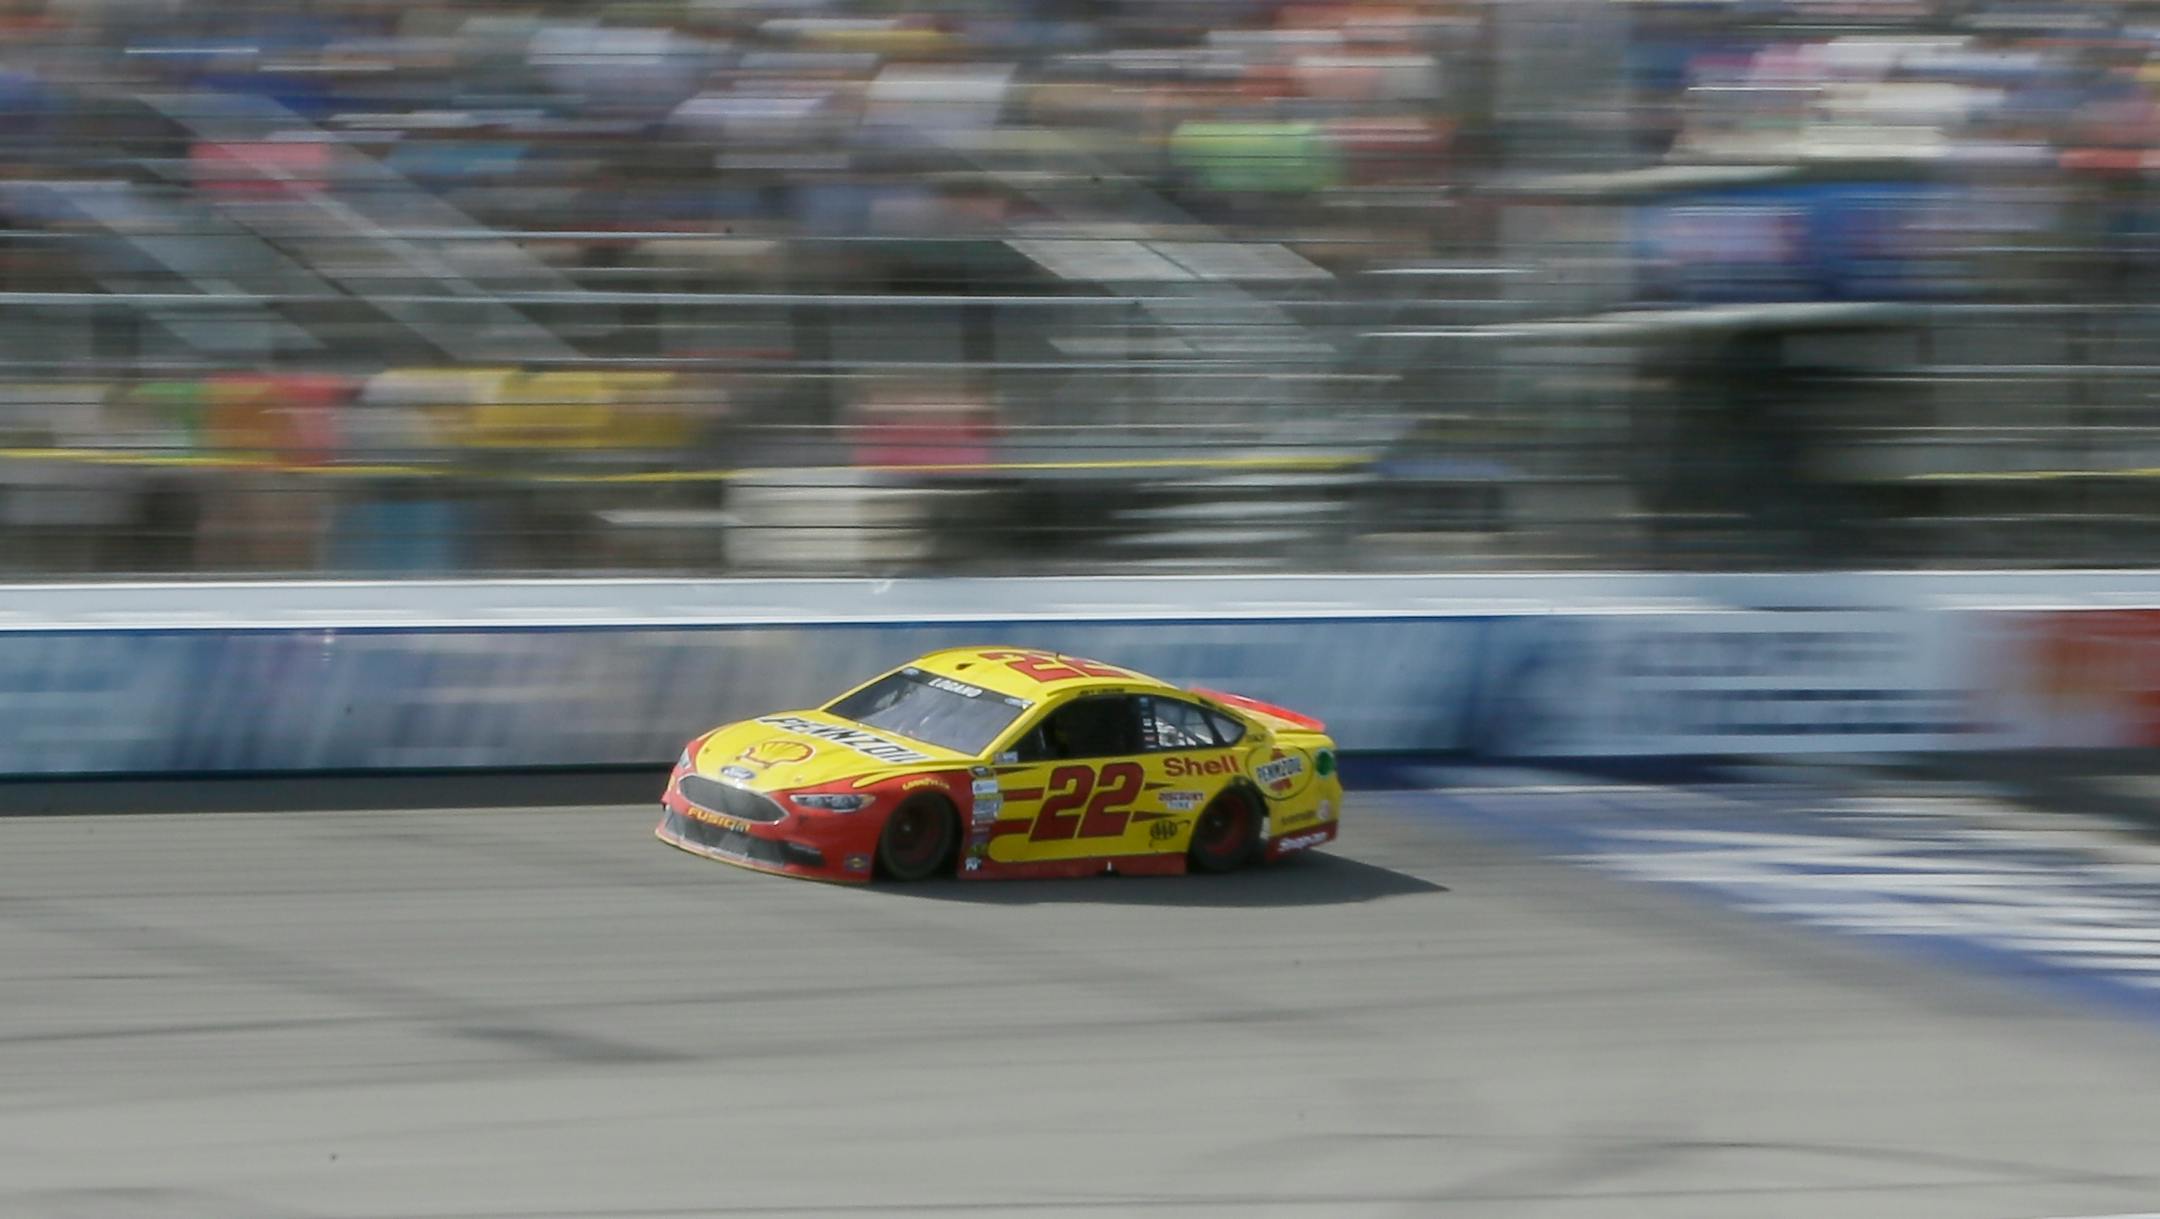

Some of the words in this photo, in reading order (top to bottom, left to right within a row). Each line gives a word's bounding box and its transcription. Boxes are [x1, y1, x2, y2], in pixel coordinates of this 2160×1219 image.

[757, 717, 930, 763] PENNZOIL
[1163, 755, 1239, 776] Shell
[687, 806, 751, 832] FUSION
[1029, 761, 1145, 842] 22
